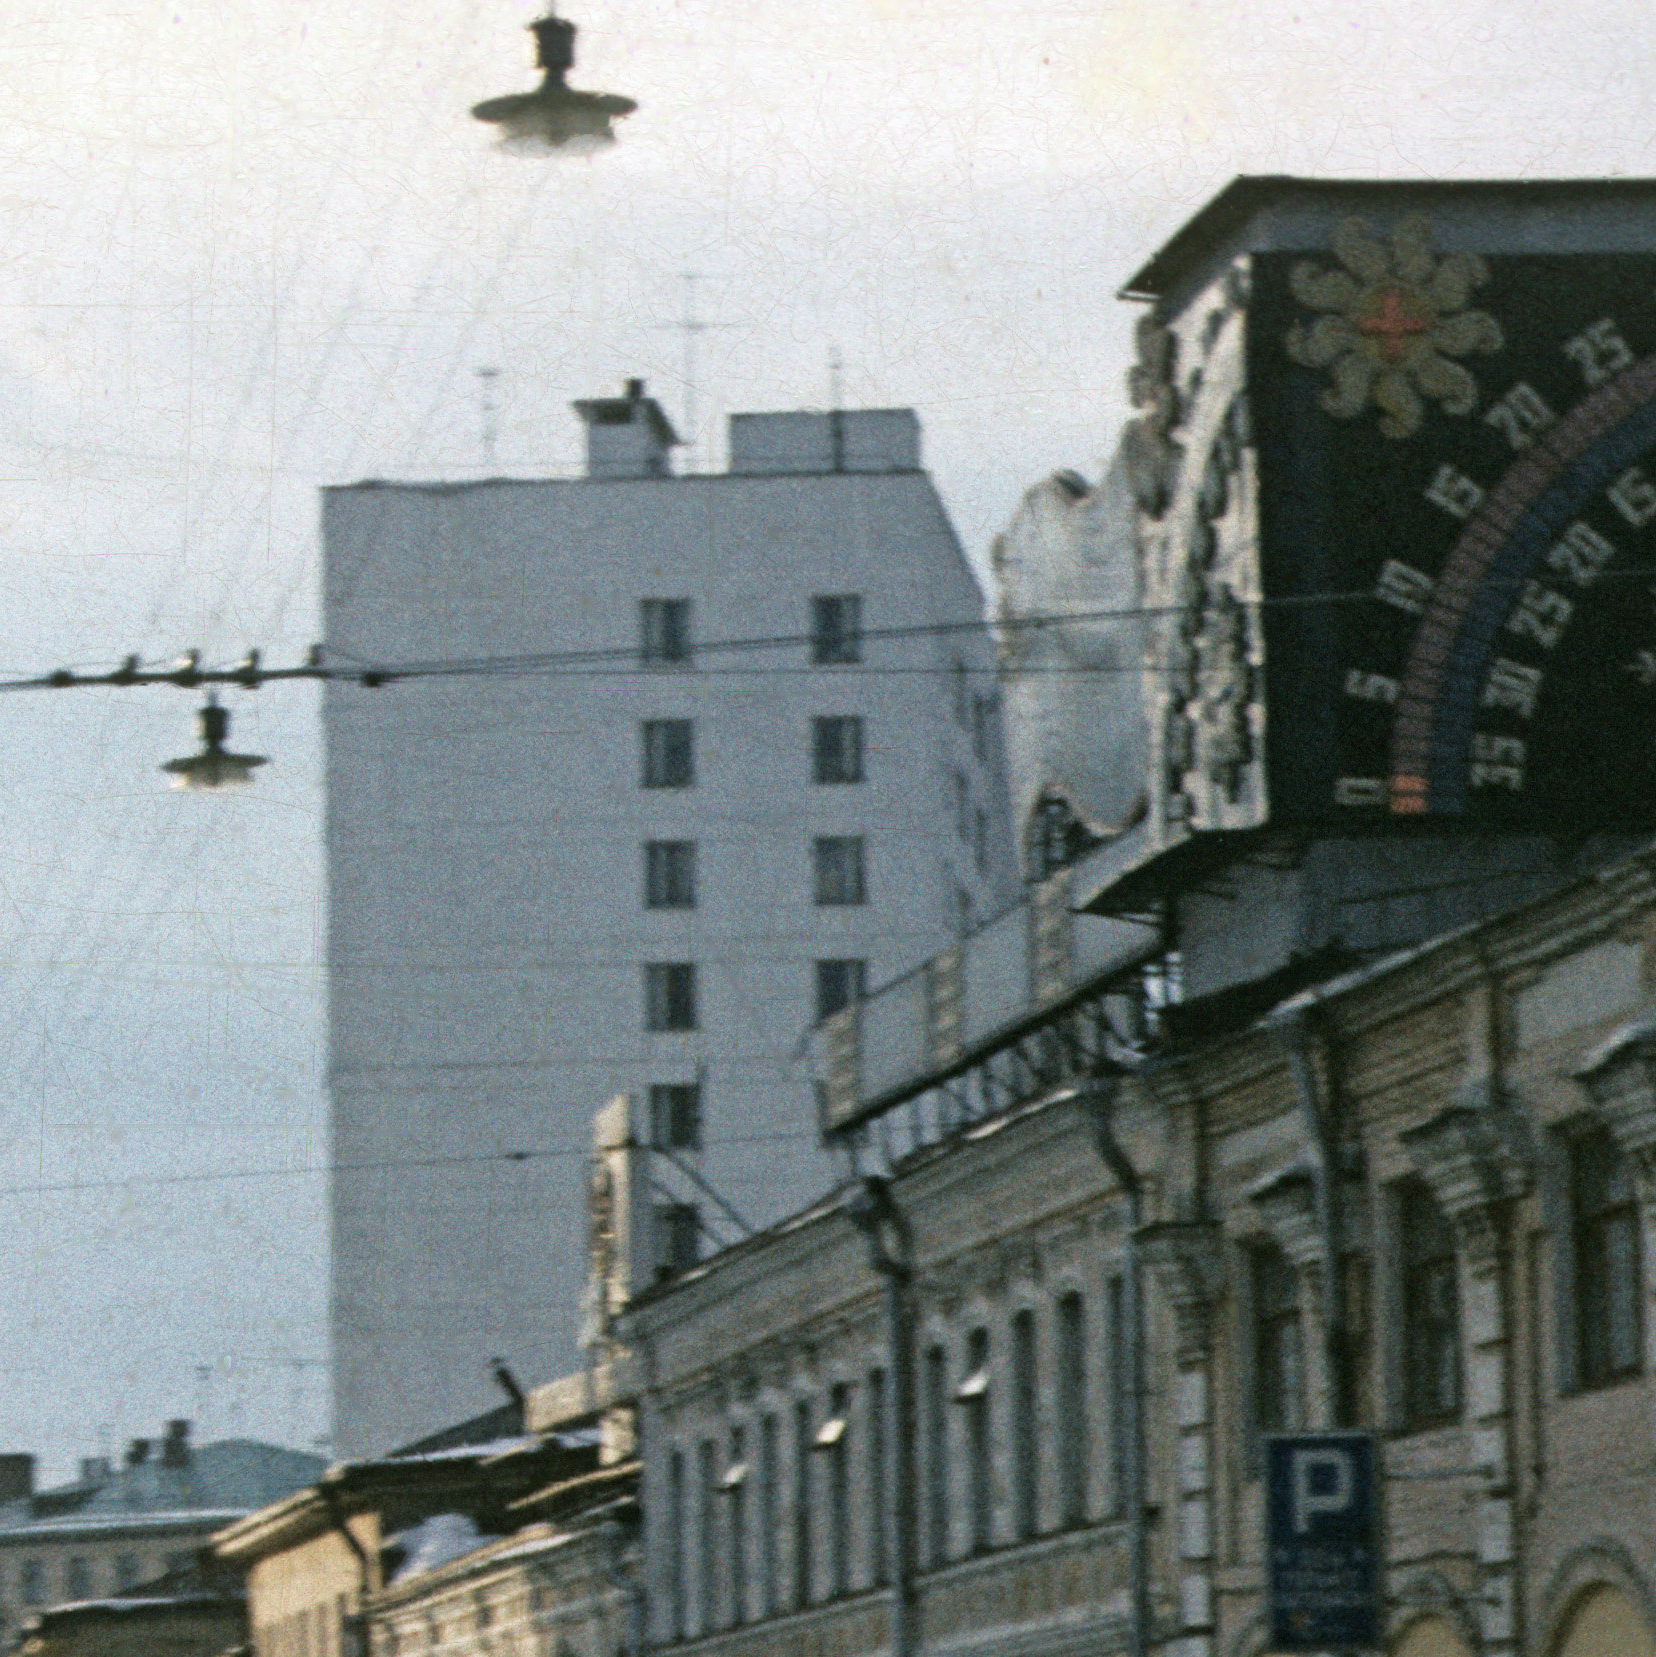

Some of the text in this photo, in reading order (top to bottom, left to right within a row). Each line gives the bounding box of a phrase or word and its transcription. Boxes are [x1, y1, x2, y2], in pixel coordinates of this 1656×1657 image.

[1345, 667, 1400, 704] 5
[1373, 559, 1434, 616] 10
[1423, 464, 1484, 520] 15
[1483, 381, 1556, 449] 20
[1564, 317, 1634, 385] 25
[1547, 521, 1616, 586] 20
[1504, 579, 1574, 649] 25
[1483, 656, 1544, 720] 30
[1469, 732, 1527, 790] 35
[1293, 1448, 1354, 1533] P
